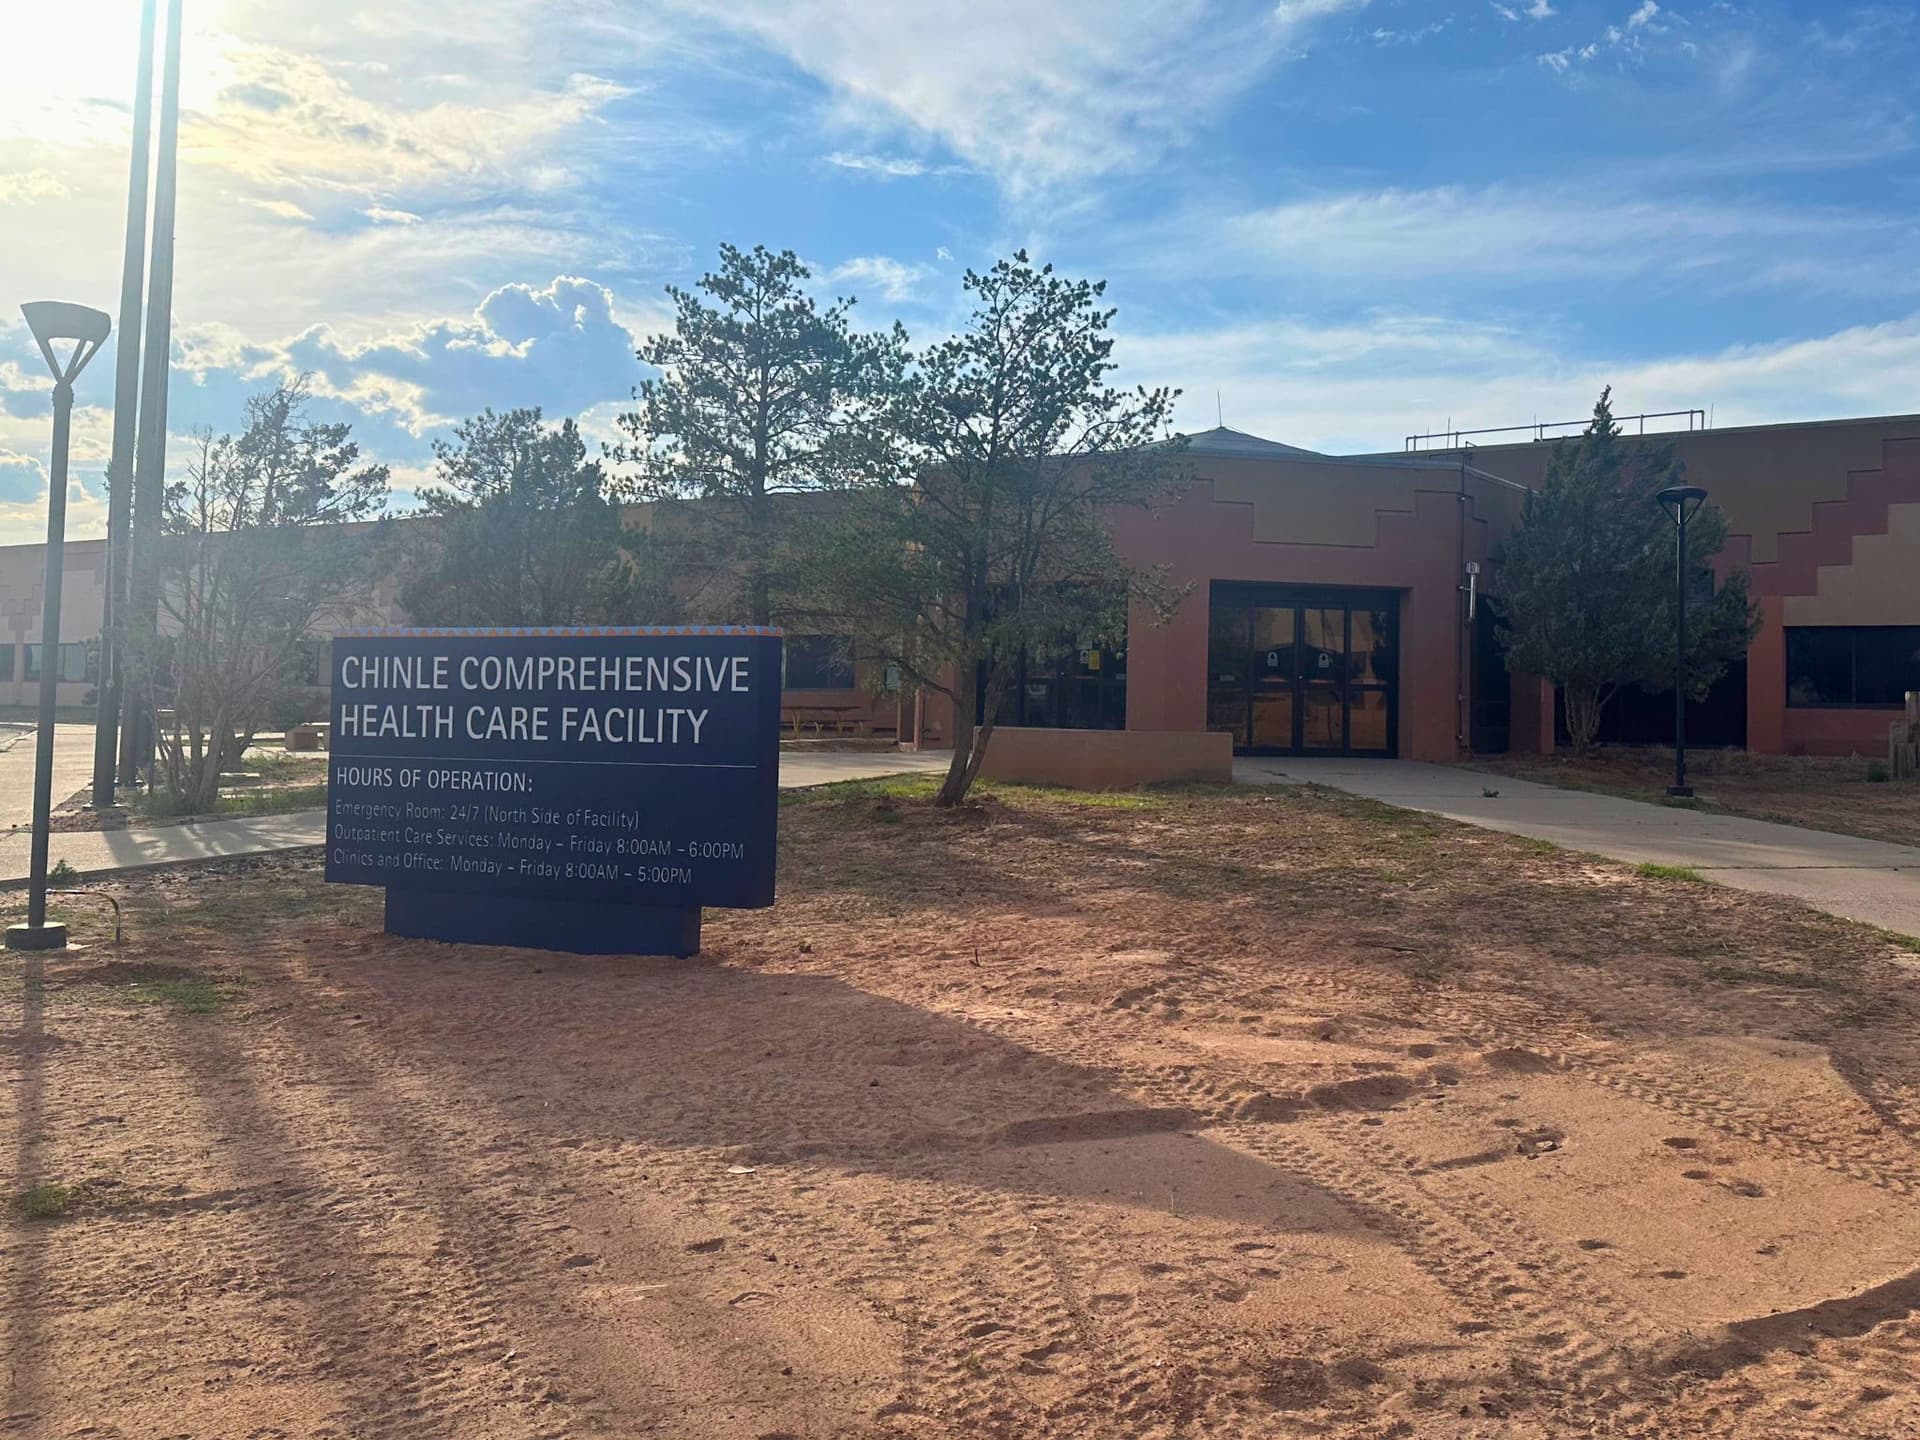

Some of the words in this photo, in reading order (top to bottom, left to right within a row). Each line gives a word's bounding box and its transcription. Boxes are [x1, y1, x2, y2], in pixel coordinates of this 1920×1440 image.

[341, 655, 449, 690] CHINLE
[459, 656, 750, 692] COMPREHENSIVE
[340, 704, 454, 738] HEALTH
[465, 705, 549, 740] CARE
[560, 706, 709, 743] FACILITY
[336, 767, 393, 787] HOURS
[399, 769, 421, 787] OF
[427, 770, 534, 792] OPERATION:
[335, 800, 401, 819] Emergency
[405, 802, 446, 818] Room:
[449, 803, 480, 821] 24/7
[483, 805, 527, 823] (North
[532, 807, 561, 825] Side
[566, 808, 582, 823] of
[584, 809, 640, 831] Facility)
[334, 822, 400, 844] Outpatient
[404, 827, 434, 843] Care
[436, 828, 495, 846] Services:
[498, 831, 553, 852] Monday
[569, 835, 613, 854] Friday
[616, 837, 673, 855] 8:00AM
[688, 841, 744, 860] 6:00PM
[333, 848, 374, 867] Clinics
[377, 853, 401, 867] and
[403, 852, 444, 870] Office:
[450, 854, 502, 875] Monday
[520, 859, 561, 879] Friday
[565, 862, 619, 879] 8:00AM
[637, 865, 693, 884] 5:00PM
